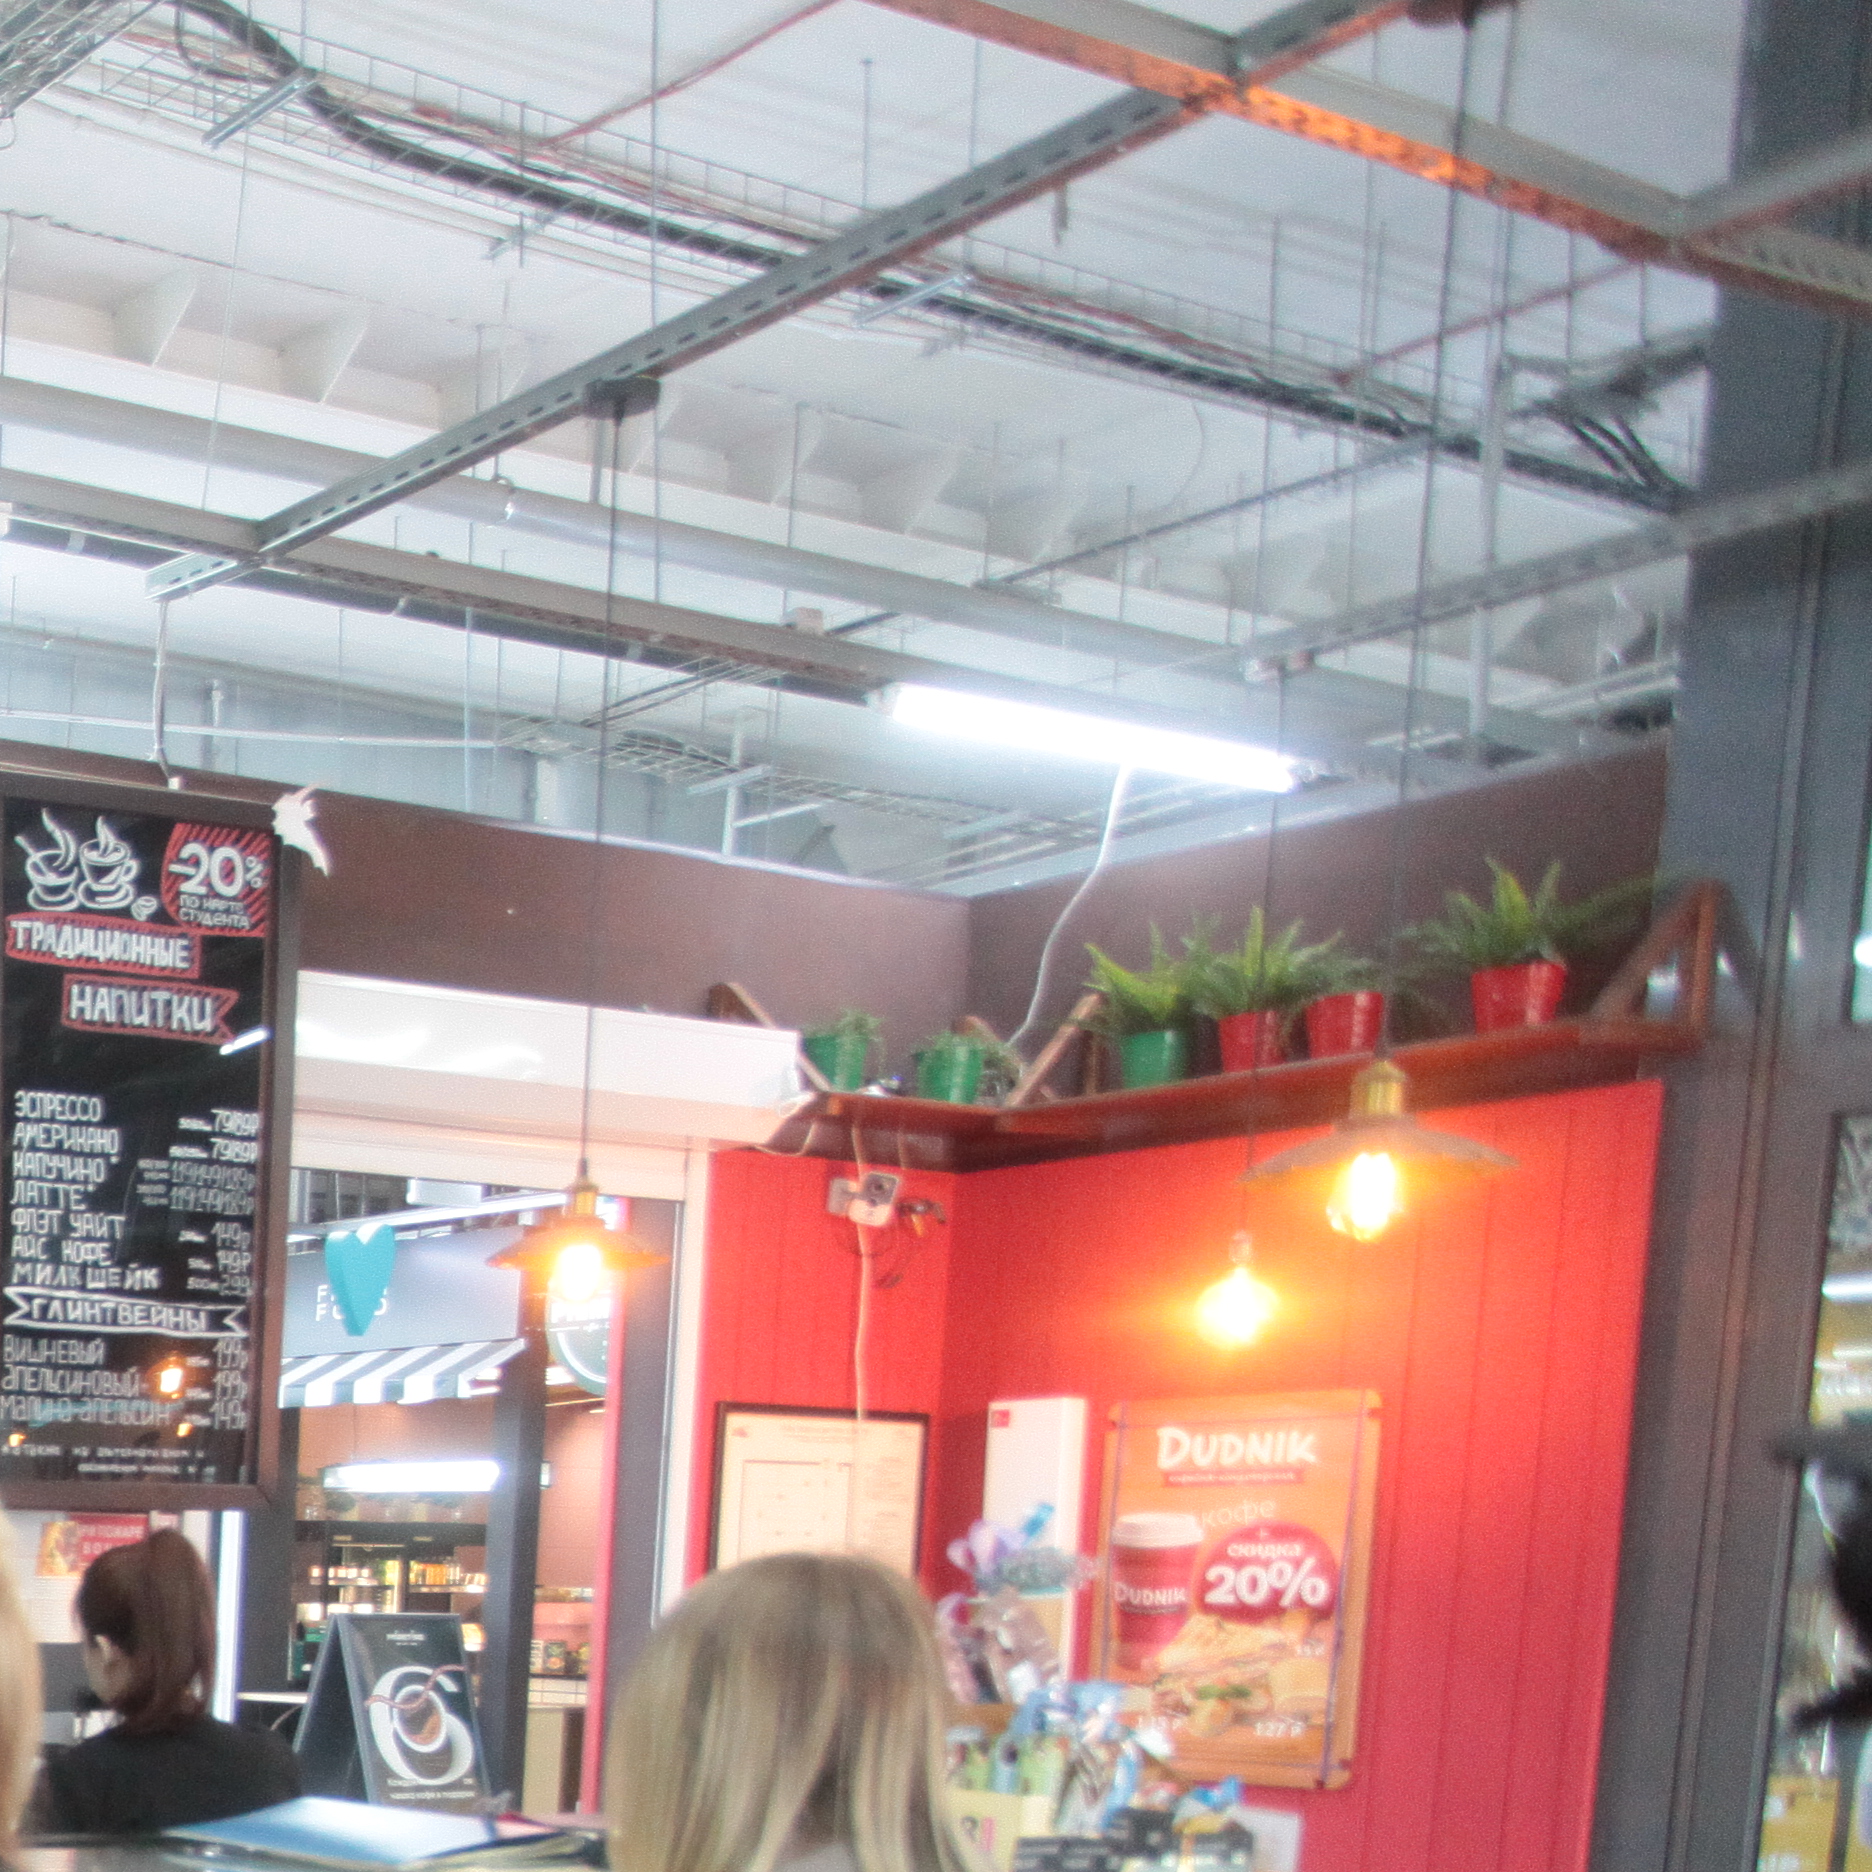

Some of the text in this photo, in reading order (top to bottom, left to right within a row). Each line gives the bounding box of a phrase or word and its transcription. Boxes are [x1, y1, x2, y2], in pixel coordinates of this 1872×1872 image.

[168, 842, 263, 898] -20%
[10, 920, 191, 970] ТРАДИЦИОННЫЕ
[69, 984, 213, 1032] НАПИТКИ
[14, 1089, 102, 1123] ЭСПРЕССО
[12, 1121, 120, 1154] АМЕРИКАНО
[11, 1208, 126, 1239] ФЛЭТ УАЙТ
[11, 1235, 112, 1267] АЙС КОФЕ
[13, 1262, 82, 1287] МИЛК
[86, 1263, 160, 1291] ШЕЙК
[30, 1298, 207, 1332] ГЛИНТВЕЙНЫ
[3, 1333, 105, 1365] ВИШНЕВЫЙ
[1157, 1427, 1319, 1470] DUDNIK
[1201, 1498, 1277, 1528] кофе
[1226, 1542, 1302, 1559] скидка
[1114, 1582, 1187, 1606] DUDNIK
[1204, 1557, 1329, 1609] 20%
